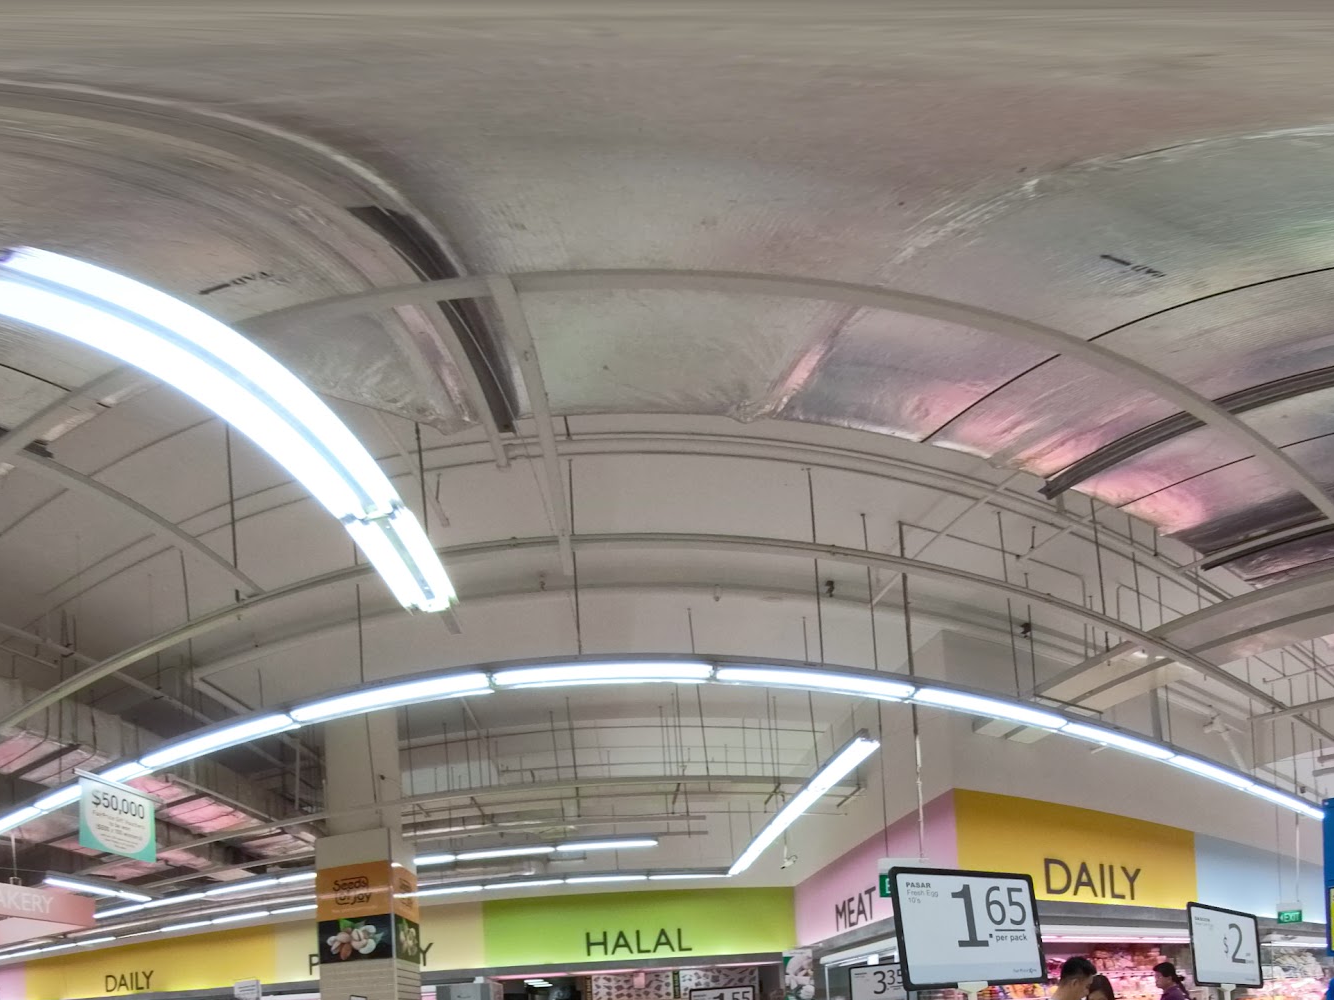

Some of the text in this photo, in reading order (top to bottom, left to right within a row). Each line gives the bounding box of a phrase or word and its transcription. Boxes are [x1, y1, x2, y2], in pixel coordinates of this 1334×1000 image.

[92, 790, 144, 819] $50,000
[332, 878, 367, 892] Seeds
[905, 881, 932, 889] PASAR
[1044, 857, 1142, 900] DAILY
[926, 890, 939, 898] Egg
[835, 886, 876, 932] MEAT
[951, 884, 1027, 948] 1.65
[1284, 912, 1300, 922] EXIT
[585, 928, 692, 956] HALAL
[1010, 933, 1028, 942] pack
[105, 970, 154, 993] DAILY
